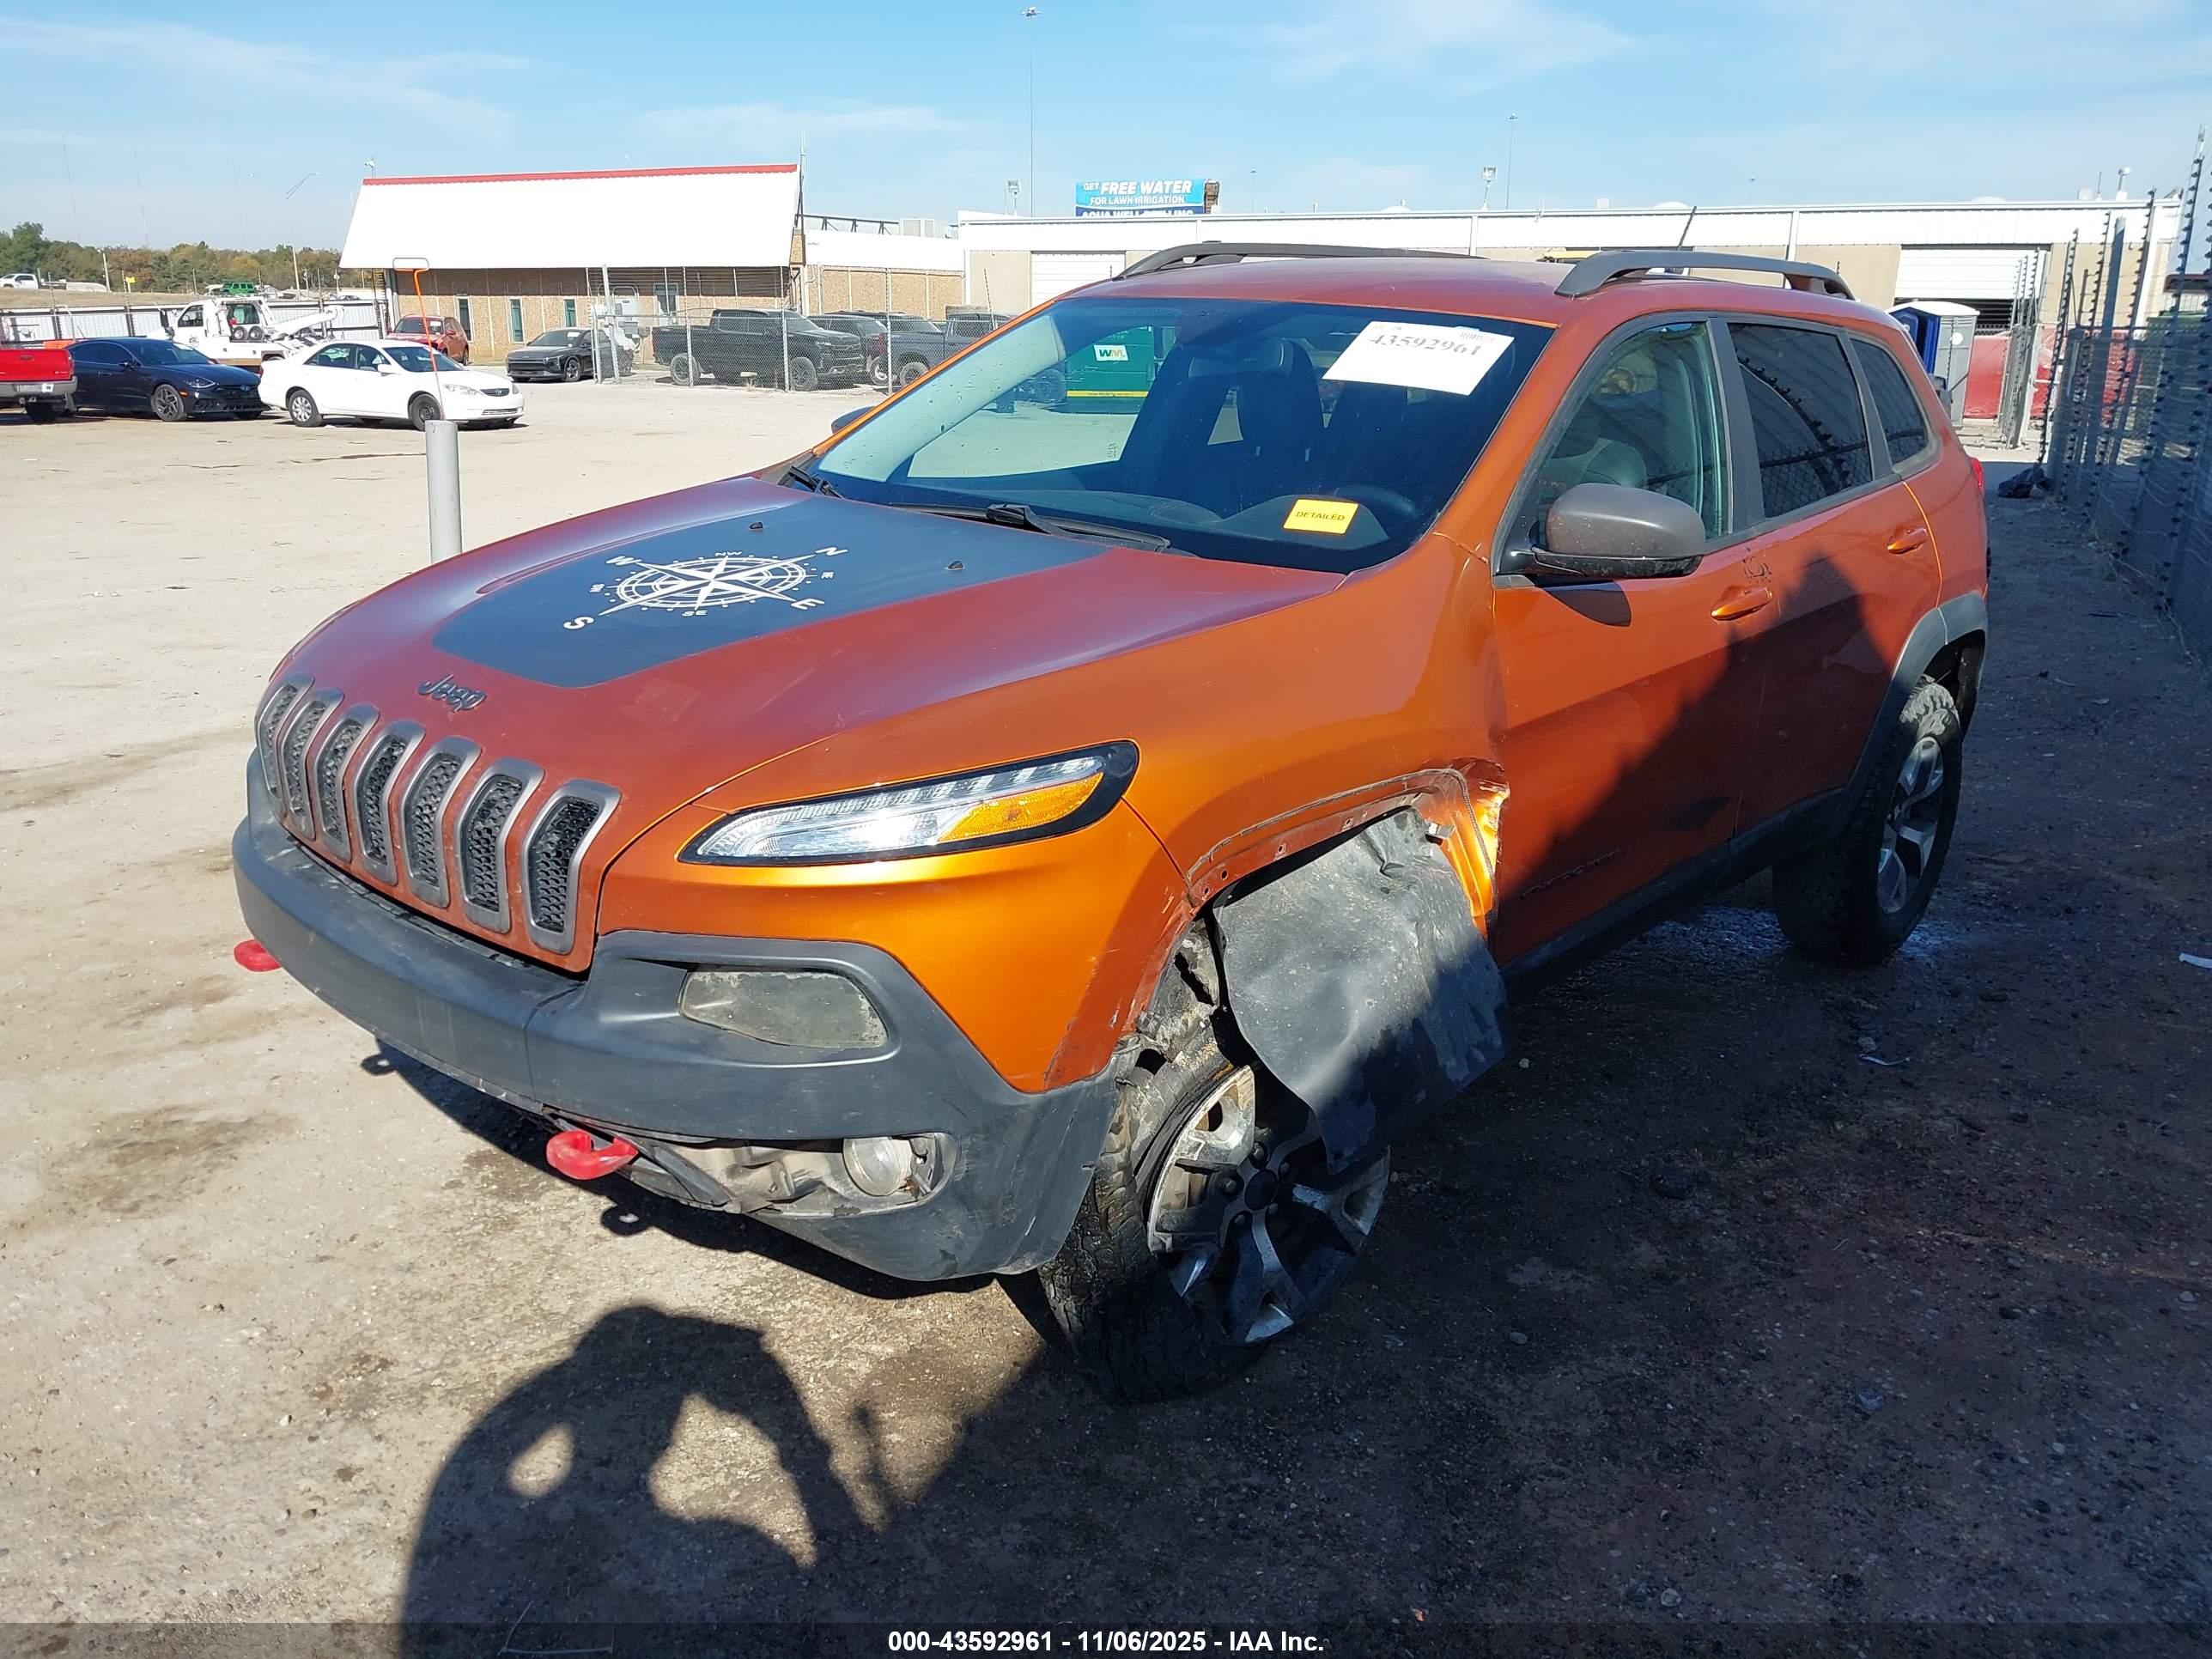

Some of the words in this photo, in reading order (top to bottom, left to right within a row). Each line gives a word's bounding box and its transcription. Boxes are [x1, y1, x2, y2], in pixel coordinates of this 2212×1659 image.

[1083, 182, 1099, 191] GET
[1100, 181, 1137, 195] FREE
[1139, 179, 1193, 194] WATER
[1090, 197, 1107, 205] FOR
[1109, 197, 1133, 205] LAWN
[1134, 195, 1185, 204] IRRIGATION
[1369, 334, 1482, 356] 43592961
[1099, 349, 1124, 358] WM
[1296, 511, 1346, 521] DETAILED
[815, 546, 848, 556] N
[605, 556, 643, 566] W
[791, 598, 825, 611] E
[562, 616, 595, 630] S
[417, 672, 488, 714] Jeep
